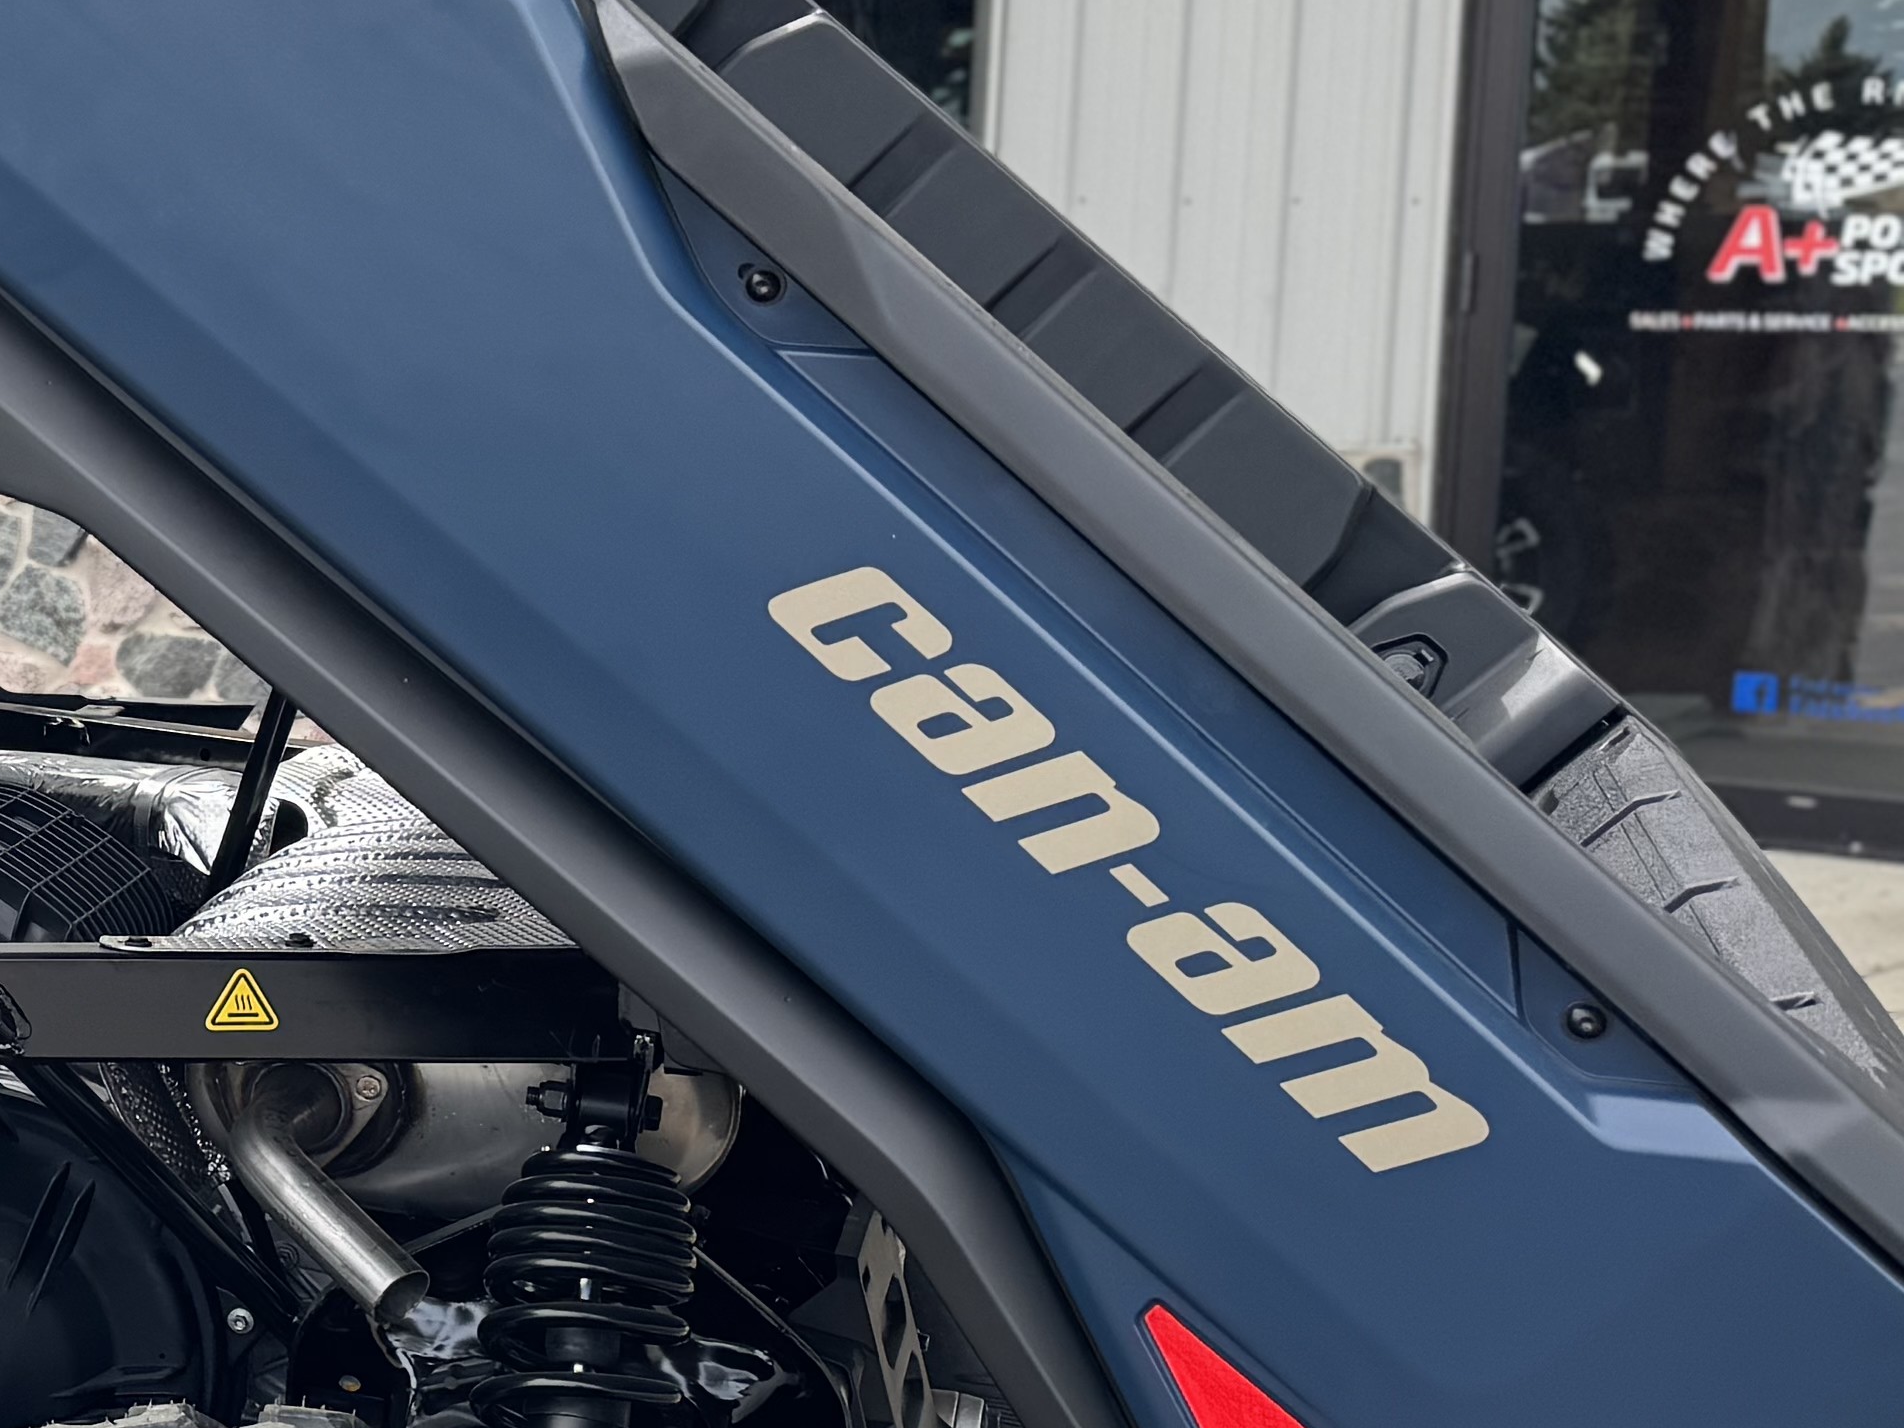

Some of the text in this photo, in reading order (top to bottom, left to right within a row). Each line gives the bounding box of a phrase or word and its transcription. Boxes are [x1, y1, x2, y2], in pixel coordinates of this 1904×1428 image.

[1642, 130, 1738, 261] WHERE
[1747, 81, 1835, 131] THE
[1706, 203, 1840, 284] A+
[767, 565, 1491, 1174] can-am
